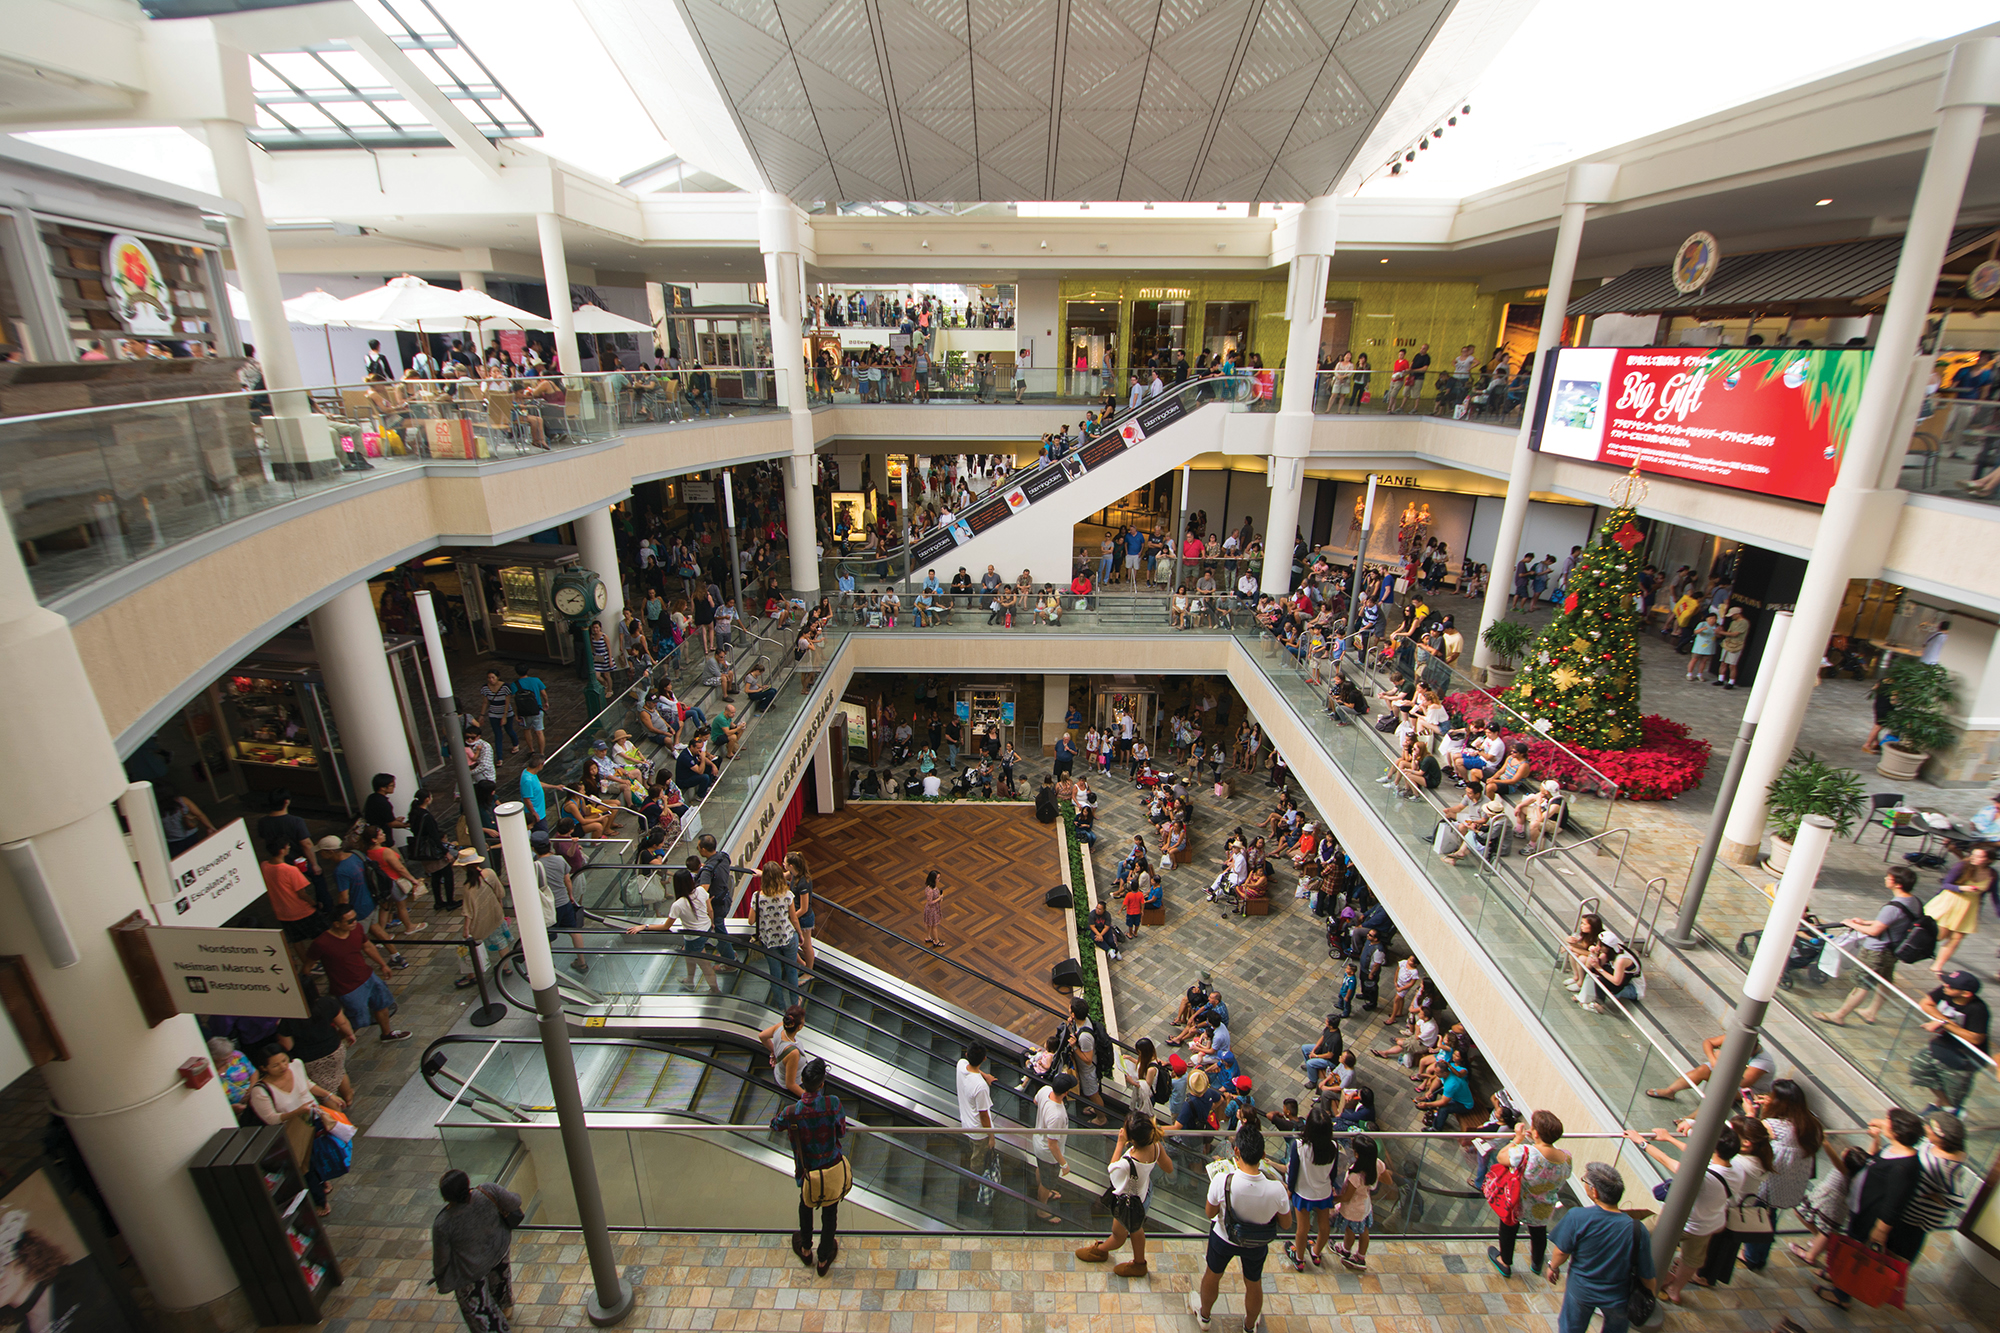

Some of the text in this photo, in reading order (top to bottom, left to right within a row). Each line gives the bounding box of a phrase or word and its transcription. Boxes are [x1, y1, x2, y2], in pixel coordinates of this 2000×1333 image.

[1615, 367, 1710, 422] Big Gift
[1765, 603, 1797, 611] PRA
[776, 688, 834, 802] CENTERSTAGE
[196, 850, 232, 877] Elevator
[190, 867, 238, 902] Escalator to
[211, 875, 241, 900] Level 3
[198, 944, 259, 954] Nordstrom
[173, 961, 265, 974] Neiman Marcus
[208, 980, 272, 992] Restrooms
